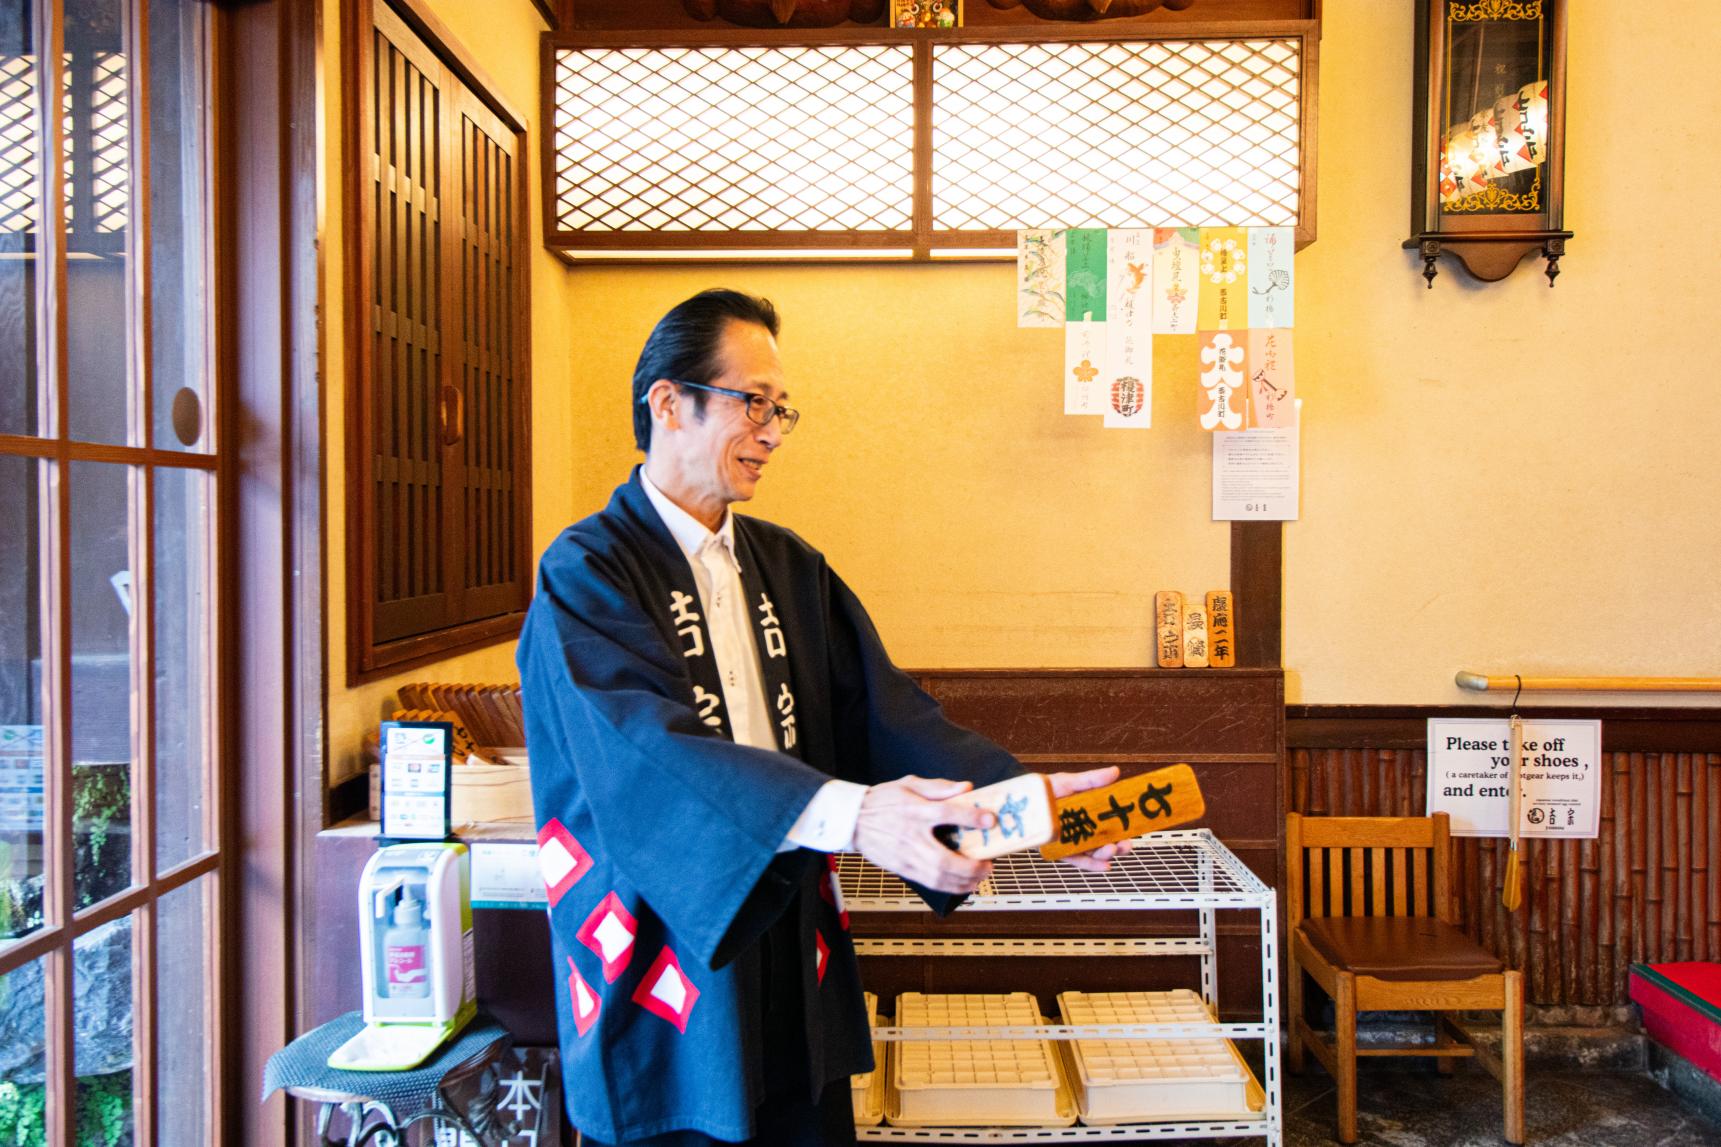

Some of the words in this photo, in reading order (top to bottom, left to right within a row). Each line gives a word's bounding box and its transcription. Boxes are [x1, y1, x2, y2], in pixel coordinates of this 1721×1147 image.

[1446, 737, 1497, 751] Please
[1543, 738, 1566, 751] off
[1491, 756, 1529, 769] yor
[1533, 754, 1579, 767] shoes
[1458, 771, 1498, 779] caretaker
[1546, 772, 1570, 780] keeps
[1443, 784, 1474, 797] and
[1059, 783, 1173, 845] 七十番
